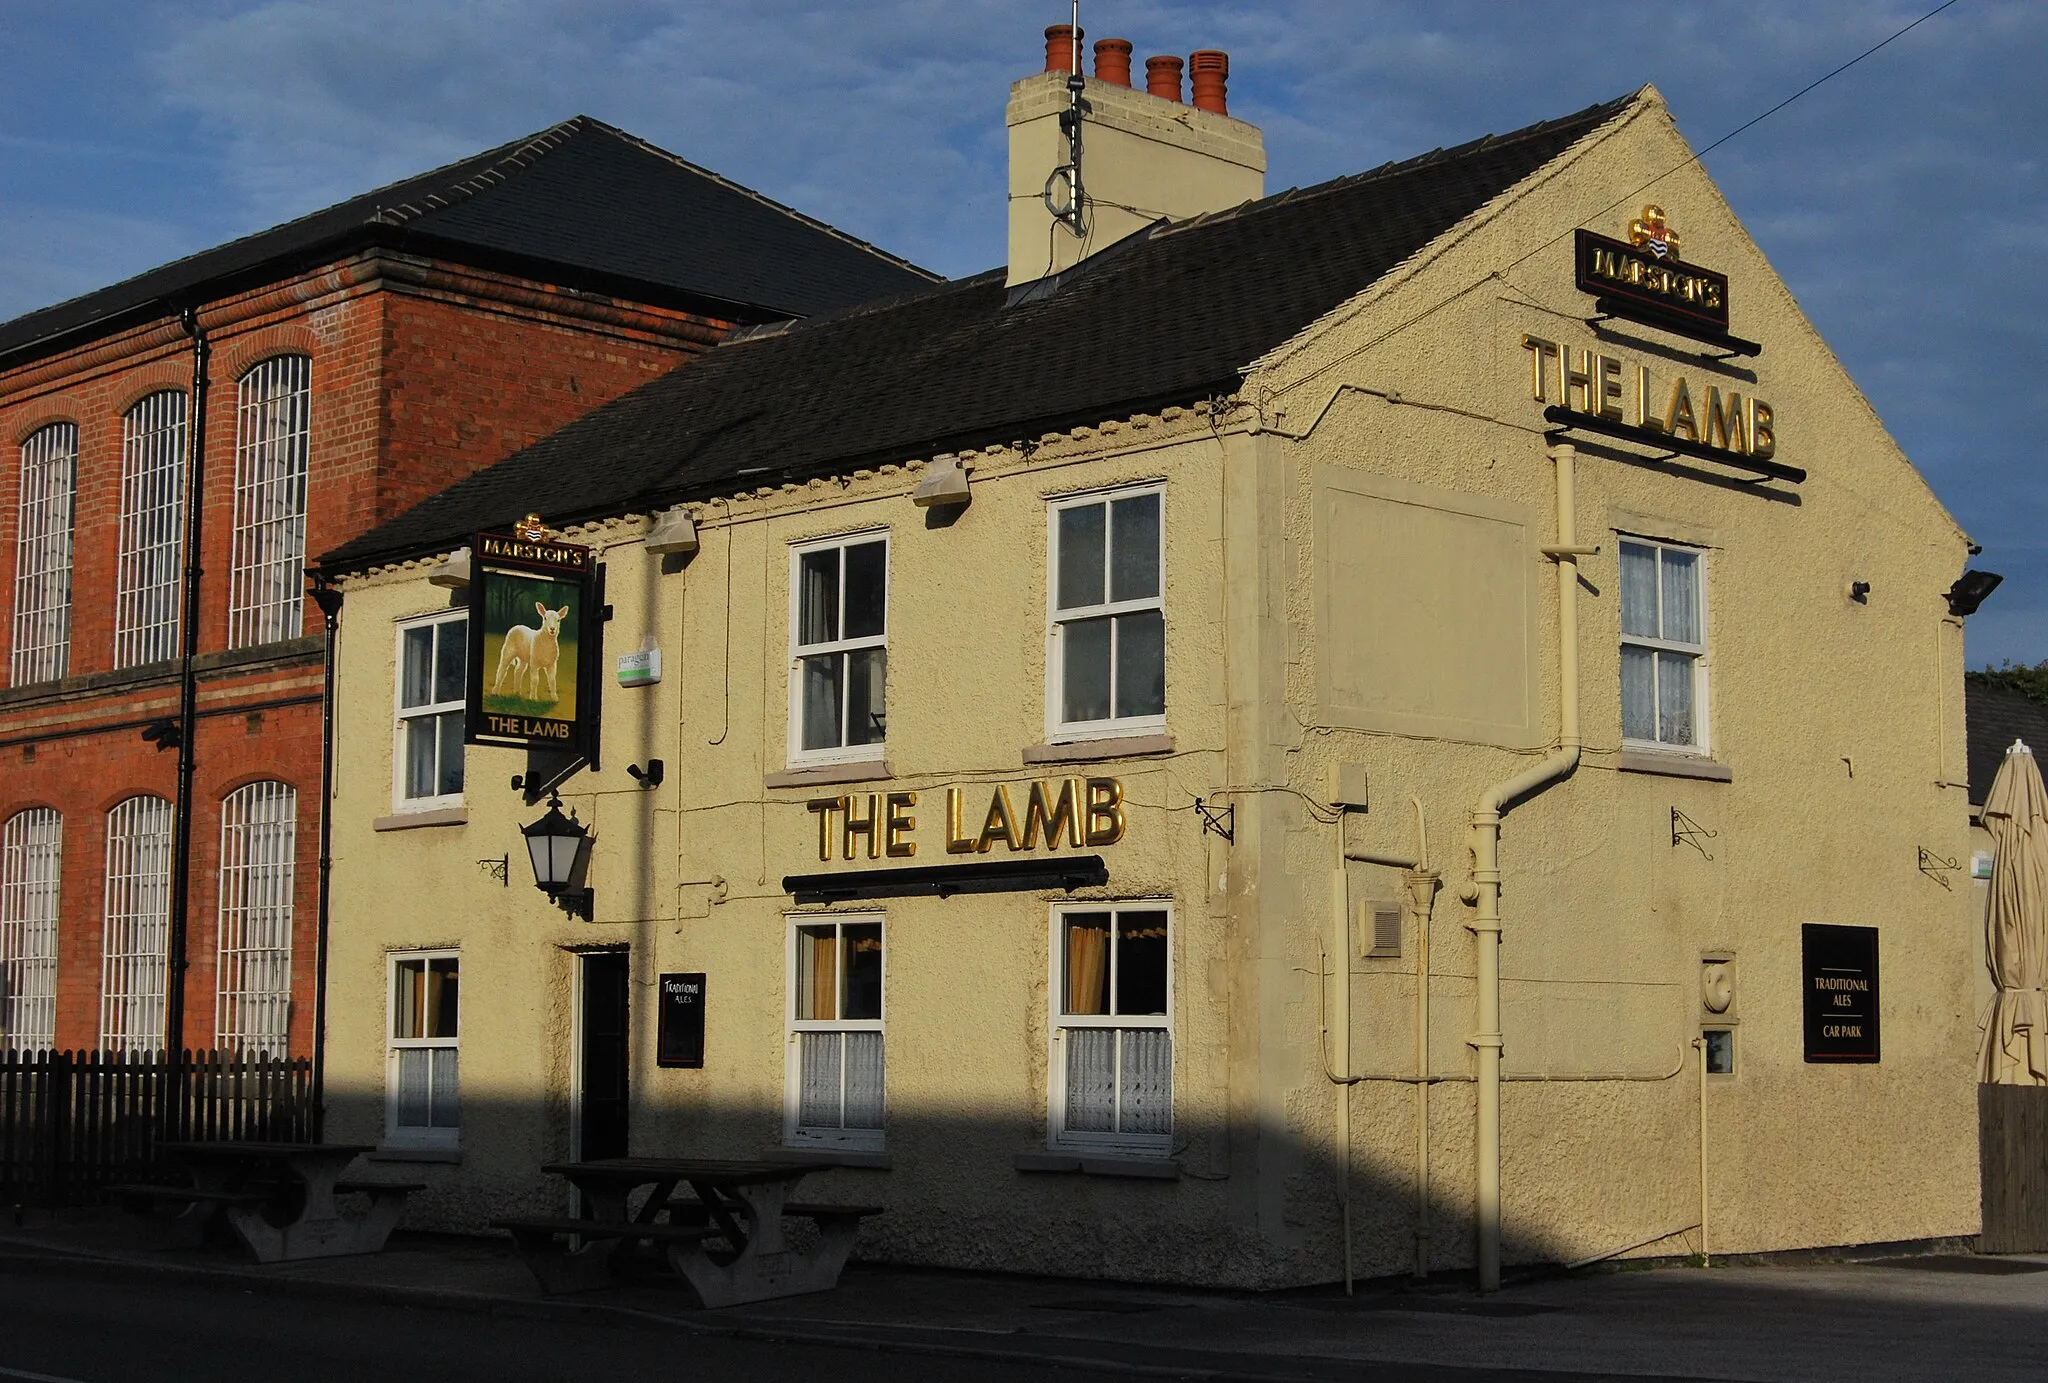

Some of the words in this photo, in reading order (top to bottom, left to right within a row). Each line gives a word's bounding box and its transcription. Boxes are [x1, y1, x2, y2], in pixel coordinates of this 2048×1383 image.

[1592, 248, 1721, 308] MARSTON'S
[1521, 334, 1623, 422] THE
[1637, 366, 1776, 460] LAMB
[484, 539, 583, 565] MARSTON'S
[488, 716, 519, 734] THE
[524, 720, 570, 739] LAMB
[807, 791, 917, 861] THE
[946, 777, 1126, 854] LAMB
[665, 980, 699, 994] TRADITIONAL
[1815, 977, 1869, 991] TRADITIONAL
[674, 995, 692, 1004] ALES
[1832, 995, 1852, 1007] ALES
[1823, 1025, 1840, 1037] CAR
[1841, 1025, 1862, 1037] PARK
